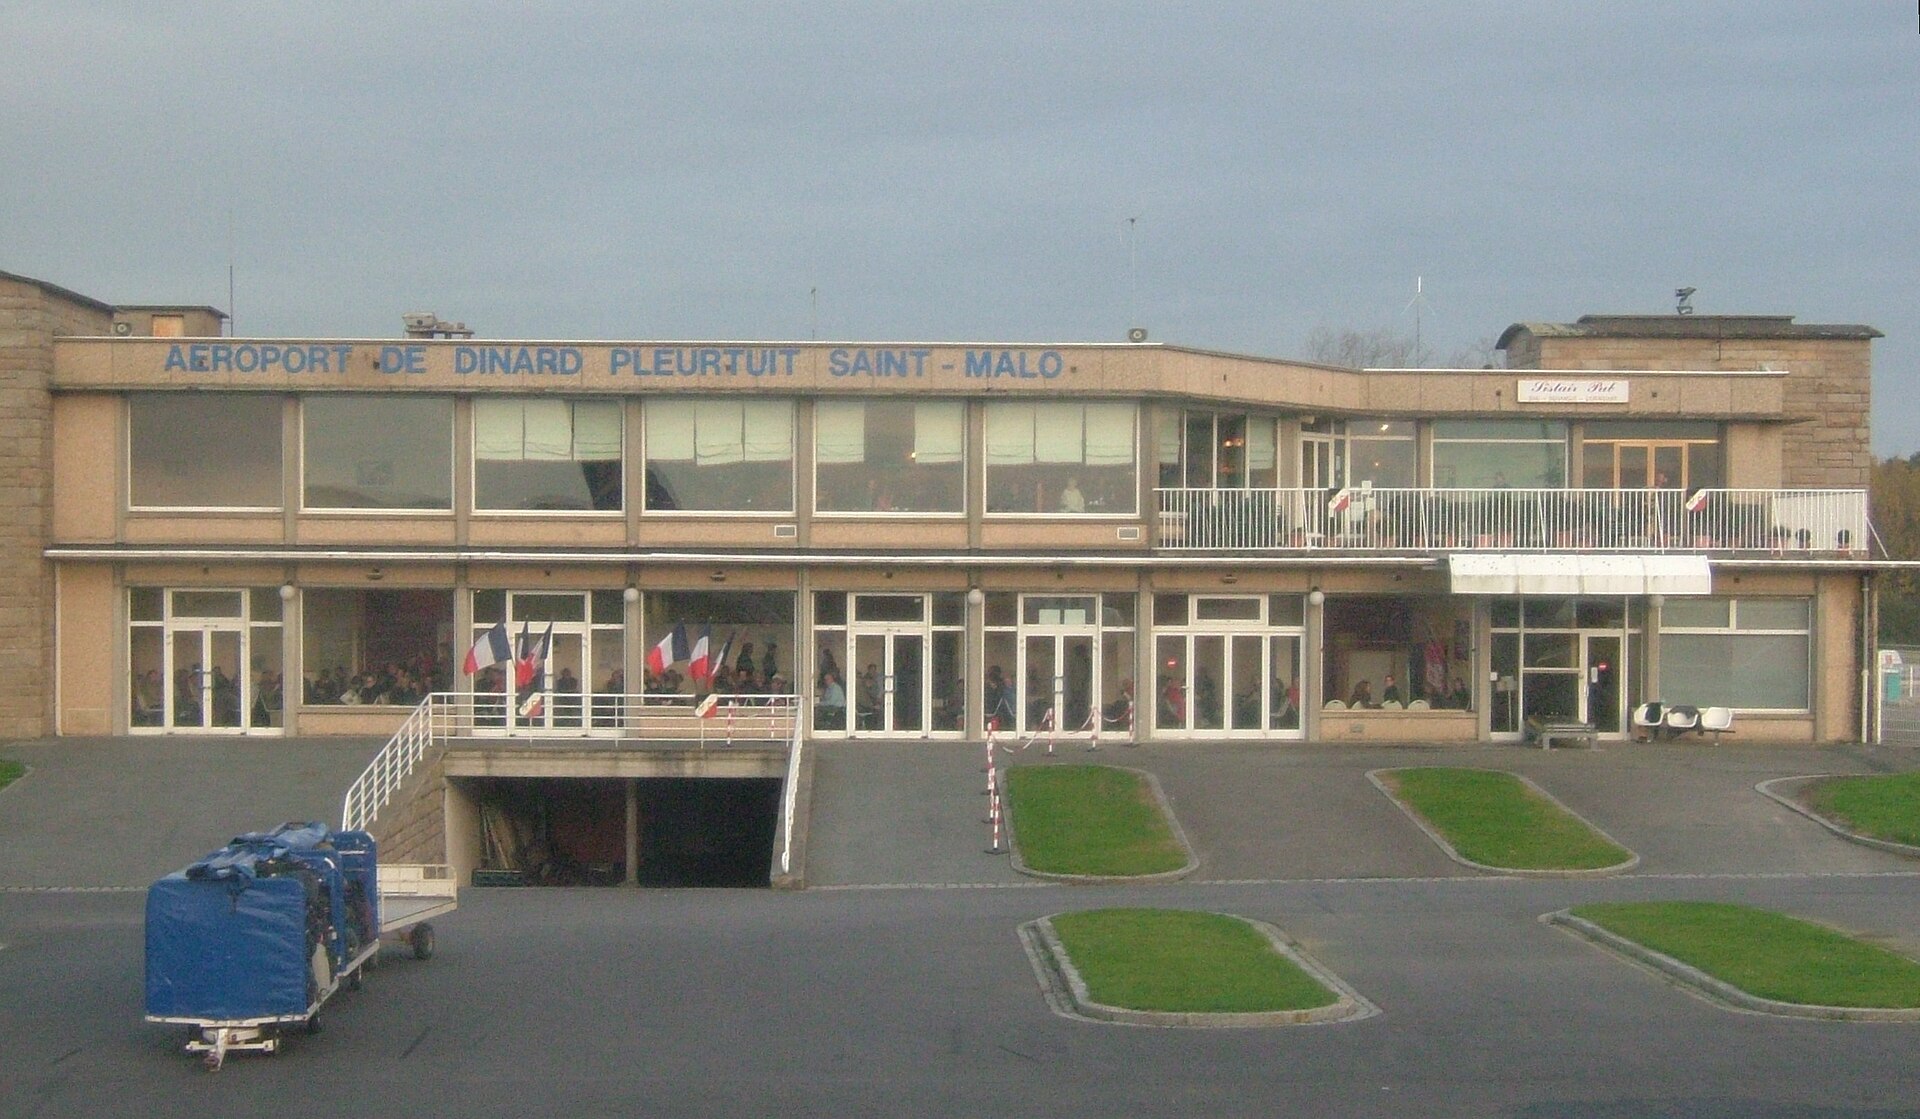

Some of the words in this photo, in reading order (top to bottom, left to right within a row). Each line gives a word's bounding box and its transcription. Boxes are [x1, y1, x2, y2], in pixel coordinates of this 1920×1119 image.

[165, 344, 351, 373] AEROPORT
[379, 345, 427, 373] DE
[456, 346, 583, 375] DINARD
[610, 348, 800, 376] PLEURTUIT
[1587, 381, 1616, 393] Pub
